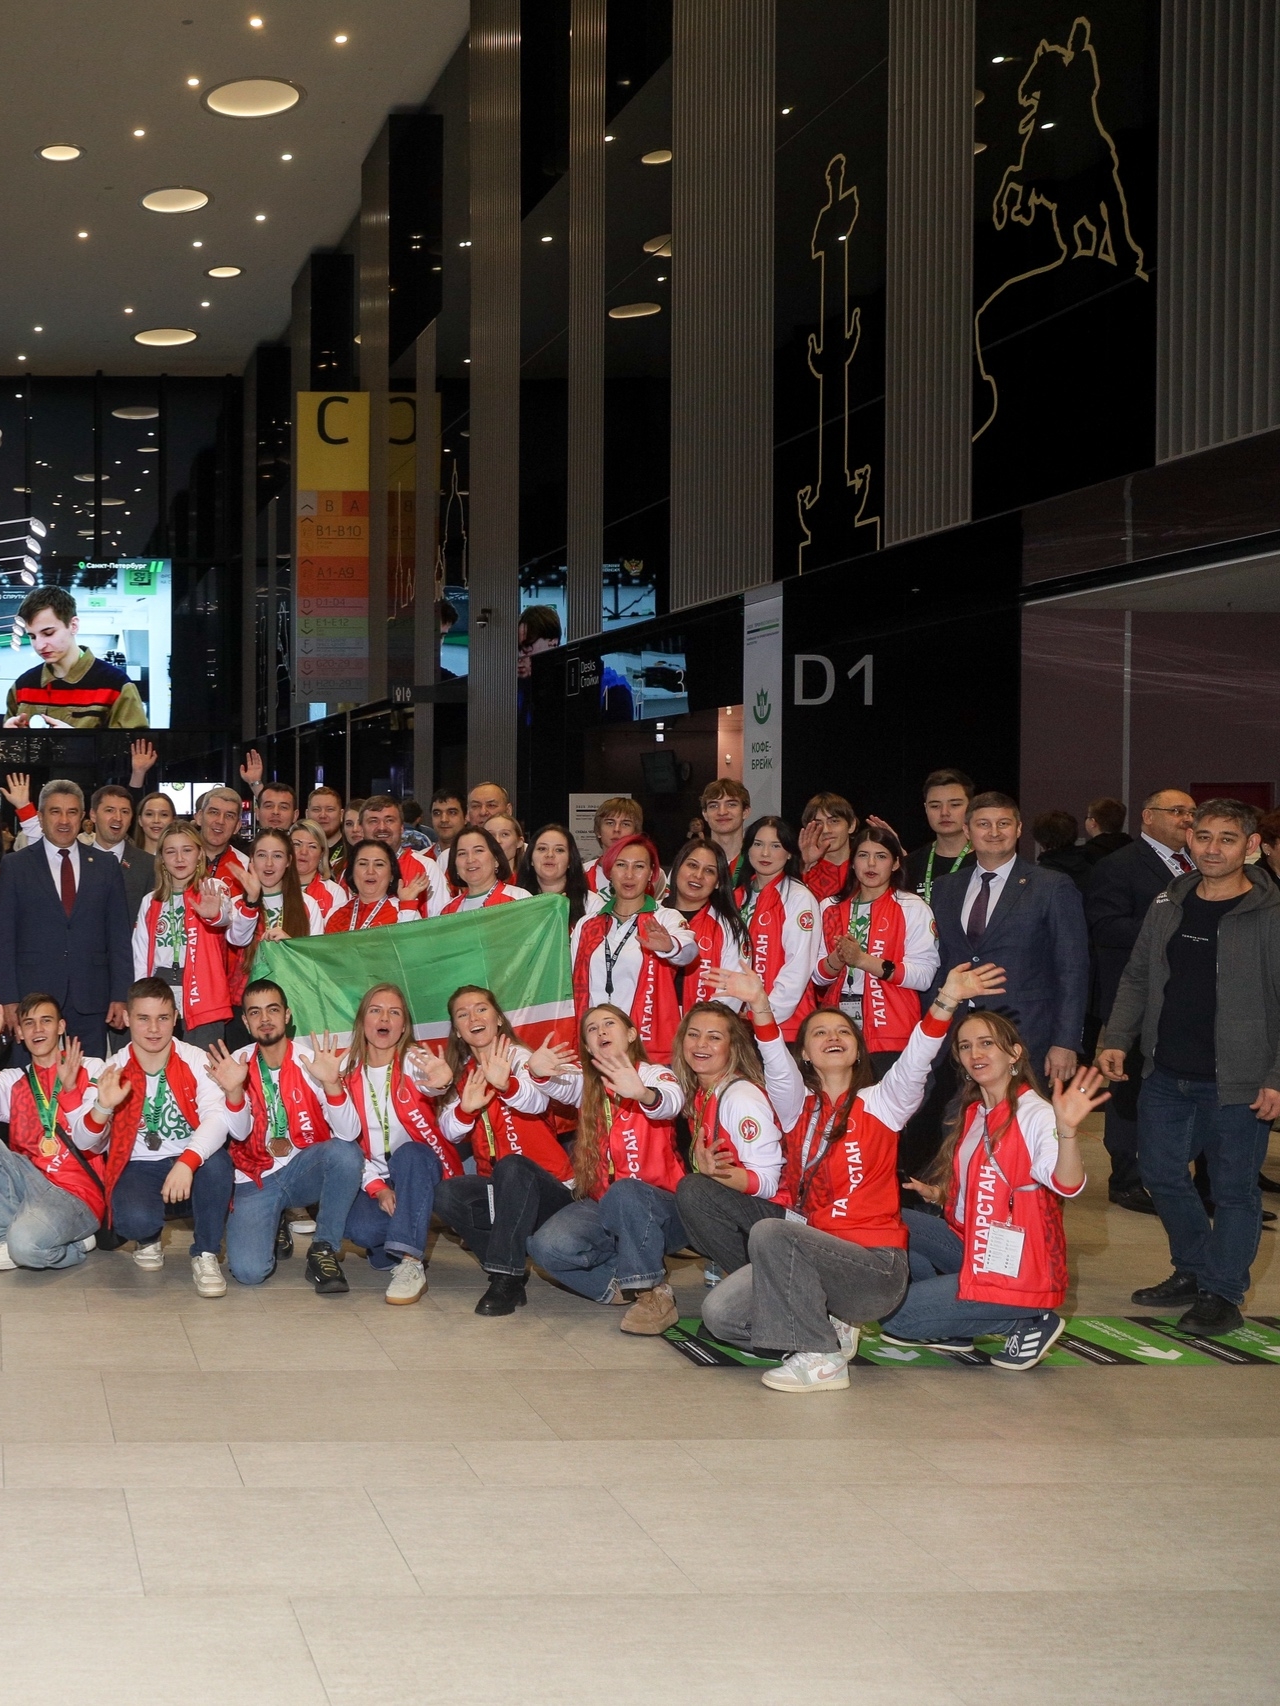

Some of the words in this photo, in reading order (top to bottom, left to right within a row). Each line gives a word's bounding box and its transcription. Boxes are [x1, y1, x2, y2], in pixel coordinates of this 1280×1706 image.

[317, 396, 350, 445] C
[325, 500, 334, 512] B
[350, 500, 360, 512] A
[316, 525, 362, 537] B1-B10
[86, 562, 148, 571] Санкт-Петербург
[317, 567, 355, 579] A1-A9
[580, 660, 596, 674] Desks
[580, 674, 599, 689] Стойки
[793, 653, 875, 707] D1
[602, 685, 609, 711] 1
[675, 669, 686, 699] 3
[751, 741, 772, 754] КОФЕ-
[751, 755, 773, 770] БРЕЙК
